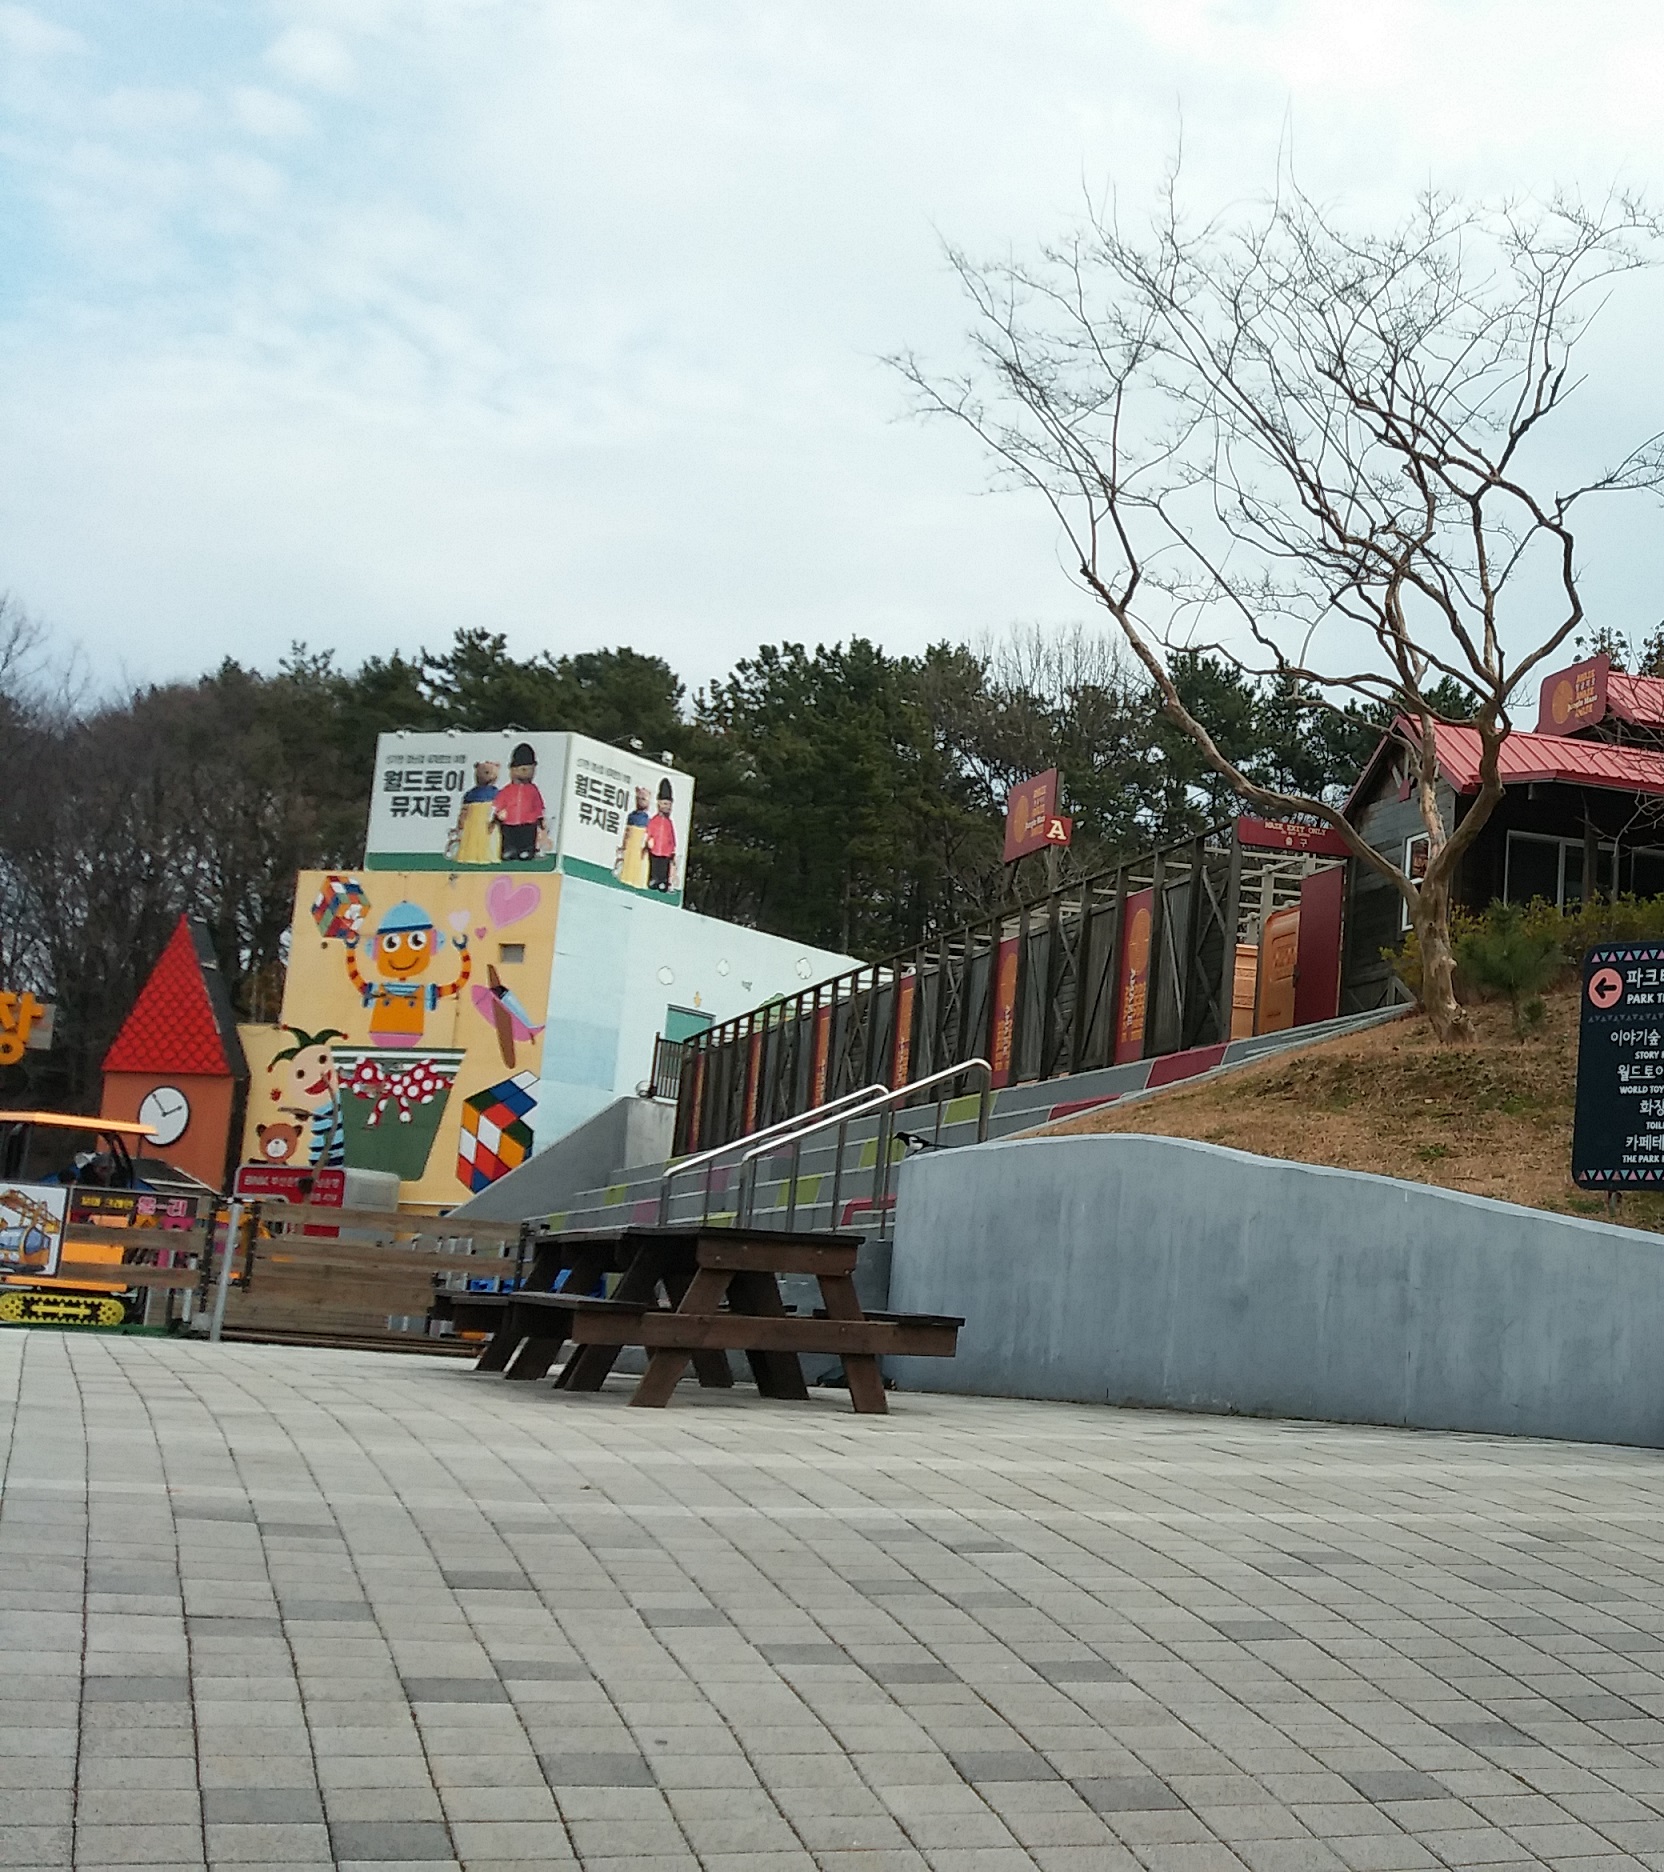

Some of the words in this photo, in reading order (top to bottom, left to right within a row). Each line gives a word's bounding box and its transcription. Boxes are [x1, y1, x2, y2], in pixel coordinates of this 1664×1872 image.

[383, 770, 464, 792] 월드토이
[575, 773, 630, 812] 월드토이
[390, 795, 451, 818] 뮤지움
[579, 801, 620, 835] 뮤지움
[1046, 819, 1067, 840] A
[1286, 824, 1306, 834] EXIT
[1308, 827, 1328, 836] ONLY
[1626, 993, 1654, 1004] PARK
[1610, 1029, 1661, 1047] 이야기숲
[1635, 1051, 1659, 1060] STORY
[1619, 1086, 1648, 1095] WORLD
[1649, 1085, 1664, 1094] TOY
[1622, 1155, 1637, 1163] THE
[1637, 1154, 1660, 1163] PARK
